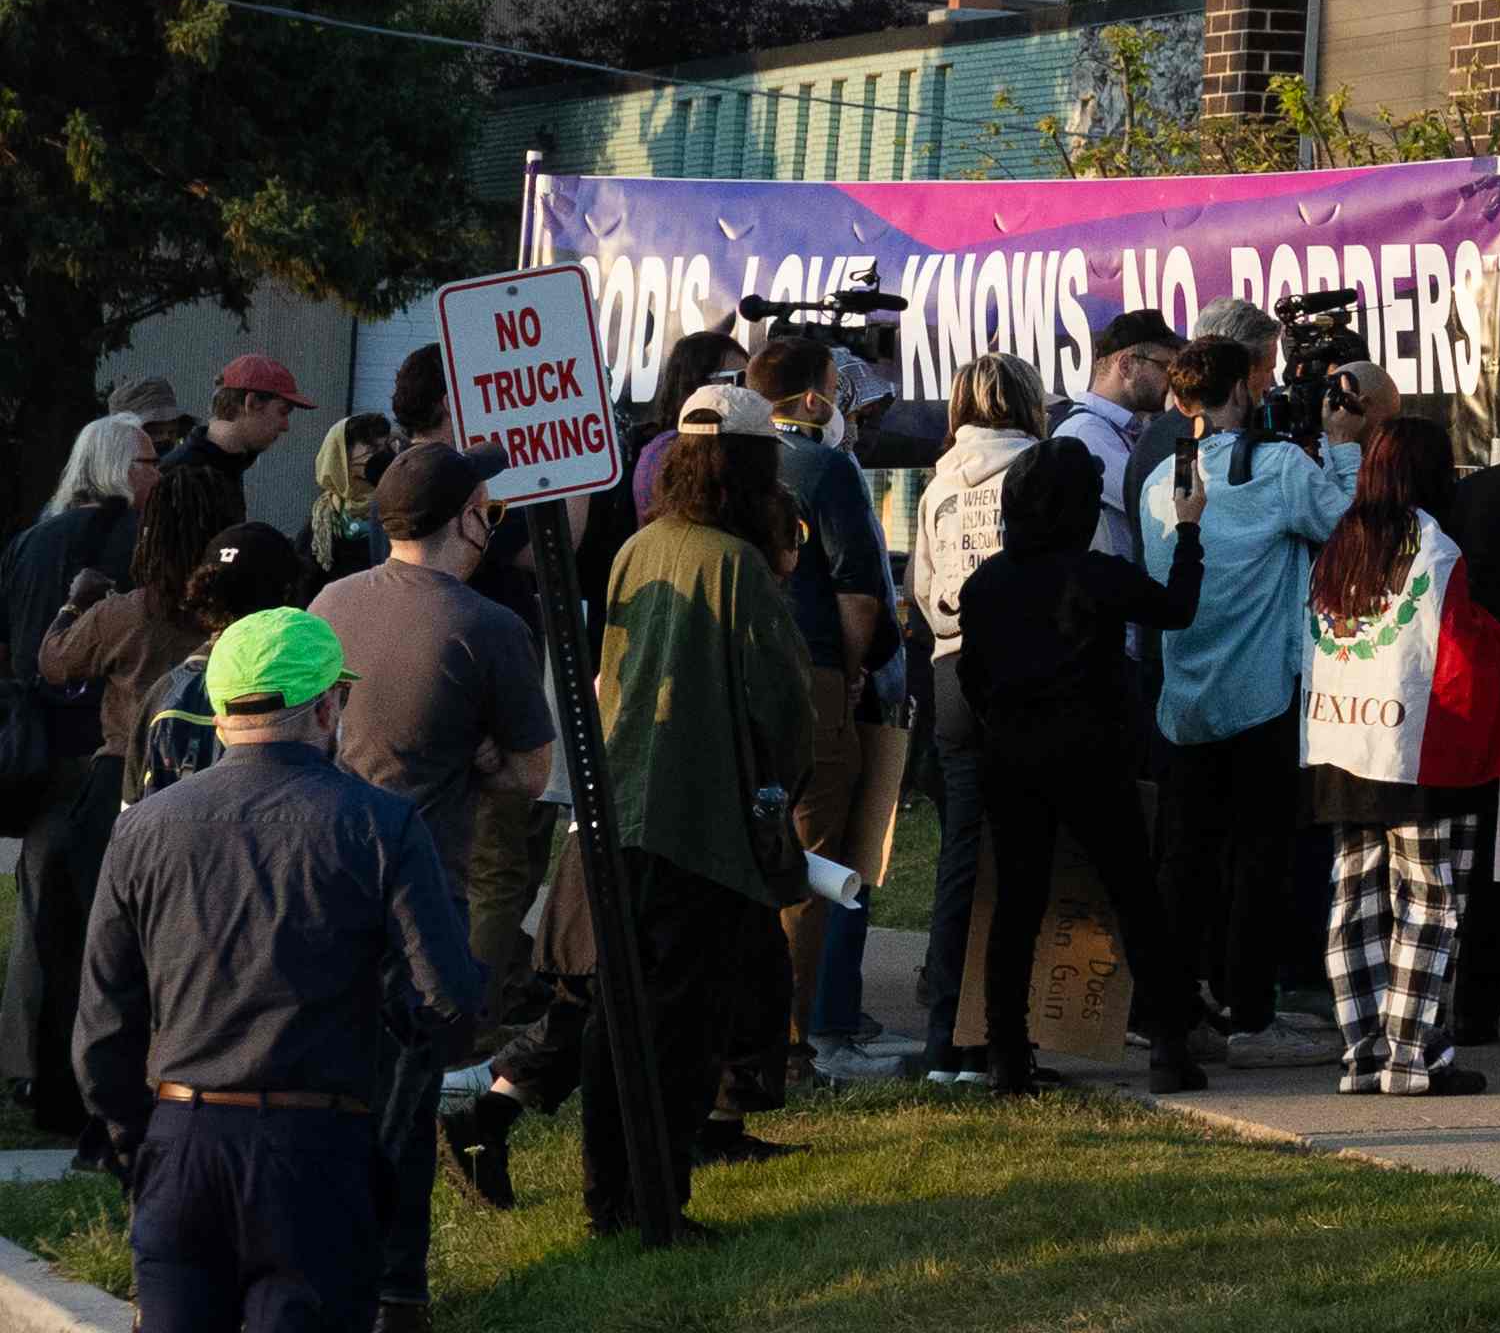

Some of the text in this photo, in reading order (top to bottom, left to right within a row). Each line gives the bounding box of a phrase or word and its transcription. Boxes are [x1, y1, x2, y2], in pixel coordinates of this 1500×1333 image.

[494, 306, 542, 352] NO
[580, 253, 711, 403] OD'S
[900, 247, 1093, 401] KNOWS
[473, 357, 583, 414] TRUCK
[962, 508, 1003, 531] INJUST
[964, 488, 999, 508] WHEN
[961, 530, 1002, 551] BECOM
[1044, 963, 1080, 1021] Gain
[1081, 958, 1119, 1022] Does
